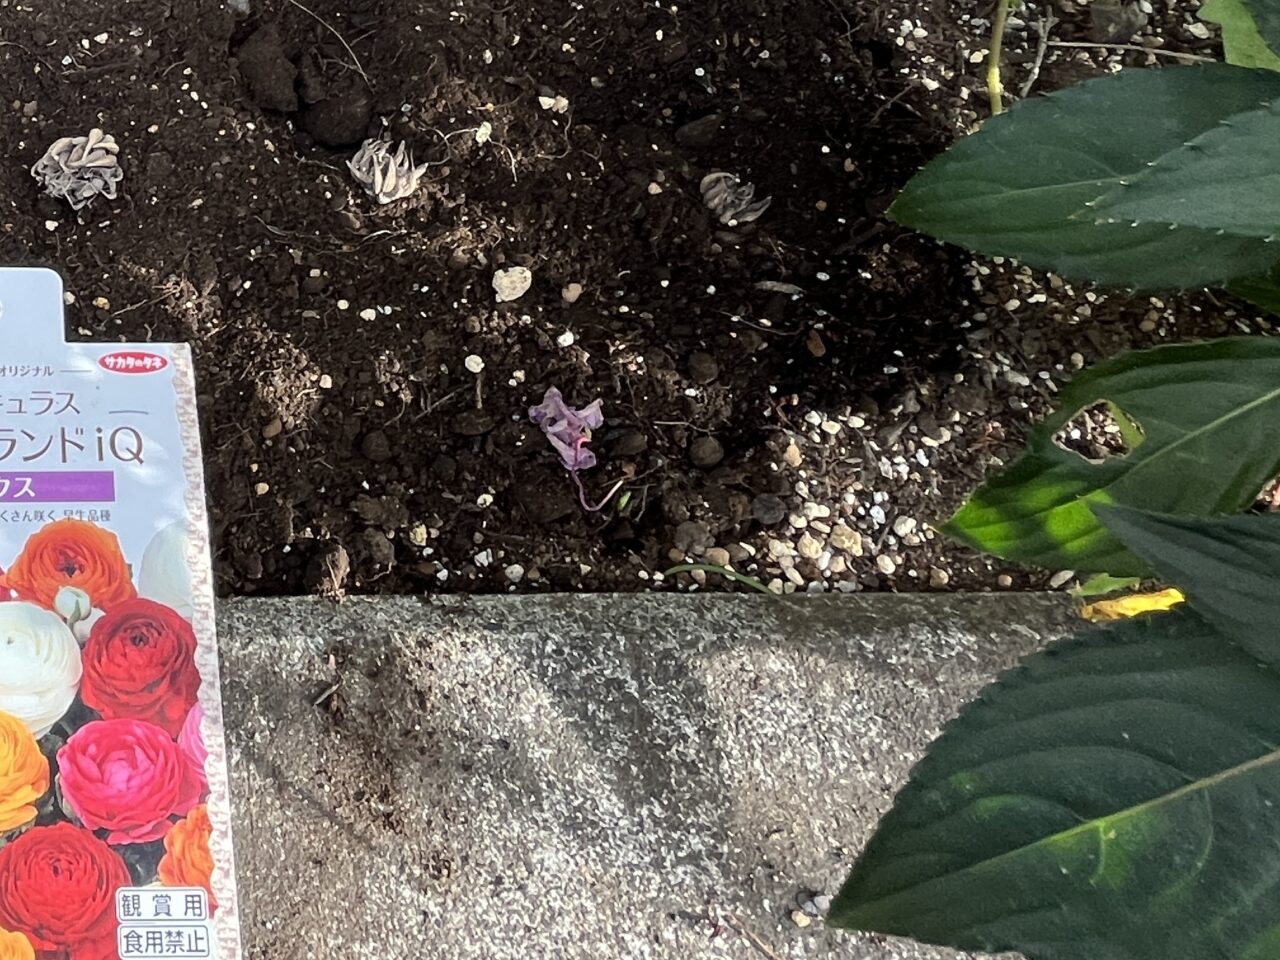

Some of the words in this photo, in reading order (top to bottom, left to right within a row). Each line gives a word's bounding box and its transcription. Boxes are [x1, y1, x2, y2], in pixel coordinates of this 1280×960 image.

[104, 356, 163, 369] サカタのタネ
[122, 894, 202, 917] 観賞用
[123, 930, 206, 954] 食用禁止
